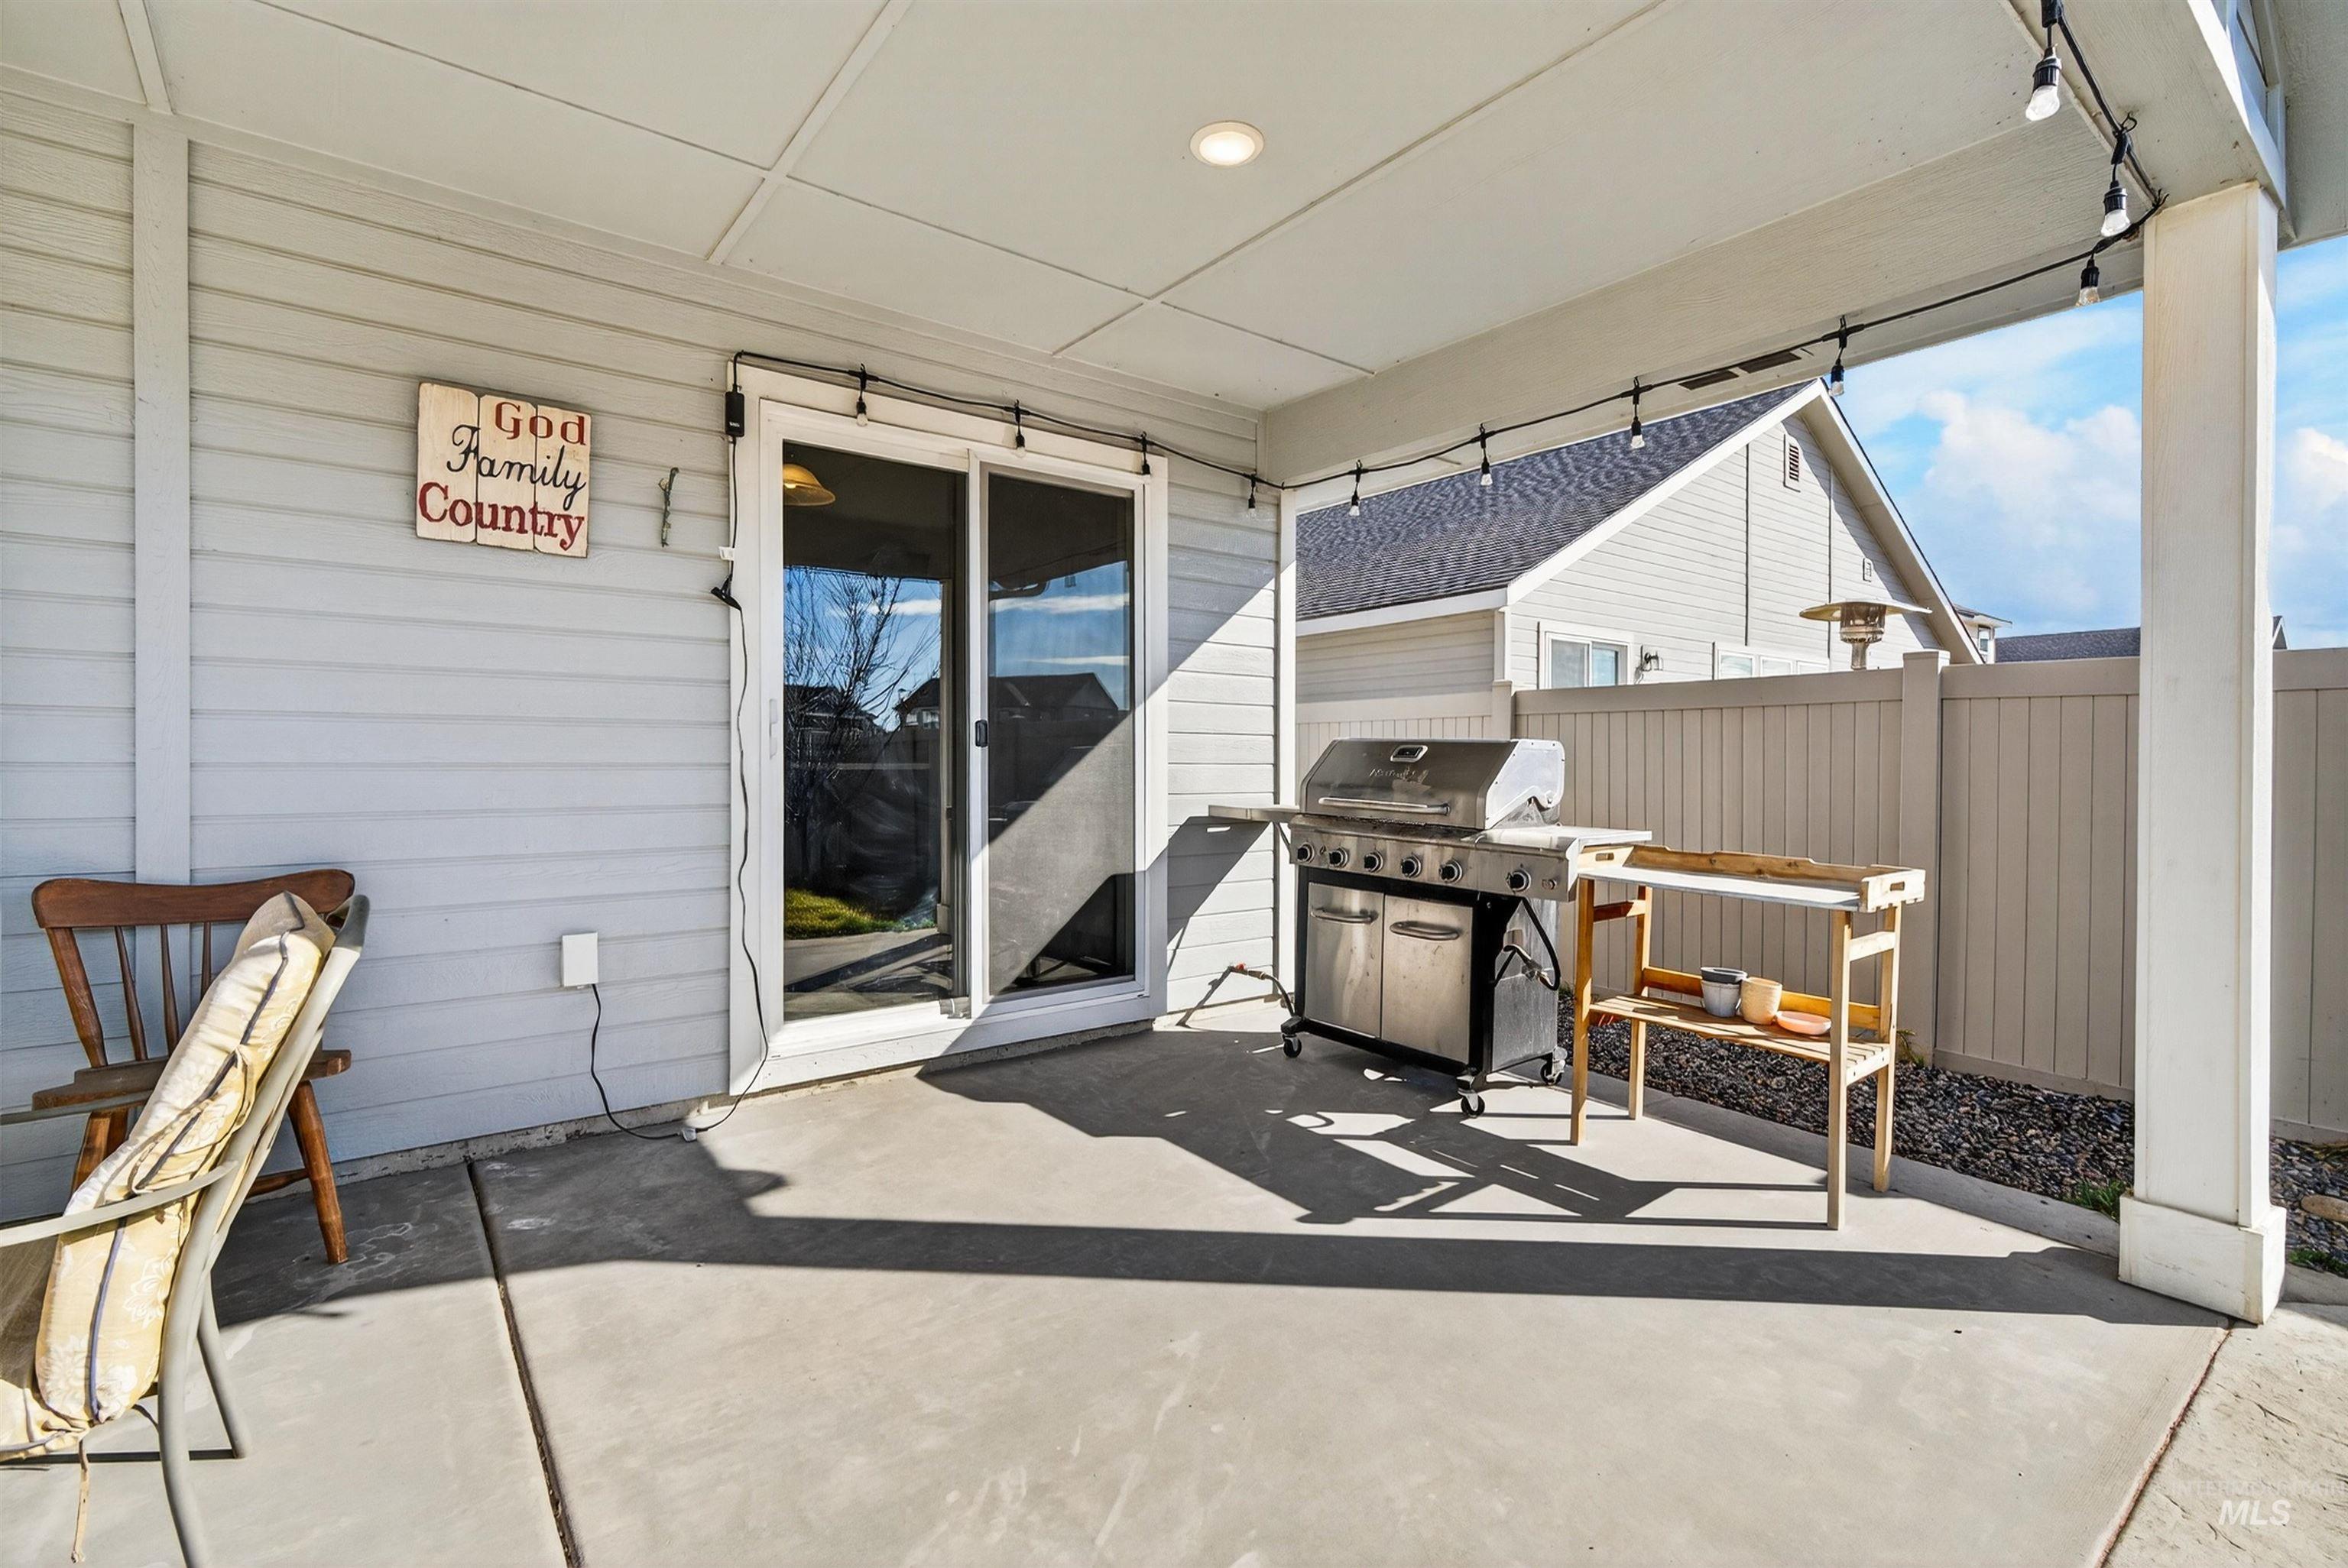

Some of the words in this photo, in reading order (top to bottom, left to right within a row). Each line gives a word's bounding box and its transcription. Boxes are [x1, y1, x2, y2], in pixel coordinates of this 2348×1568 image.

[495, 401, 586, 445] God
[446, 424, 587, 511] Family
[418, 481, 585, 551] Country
